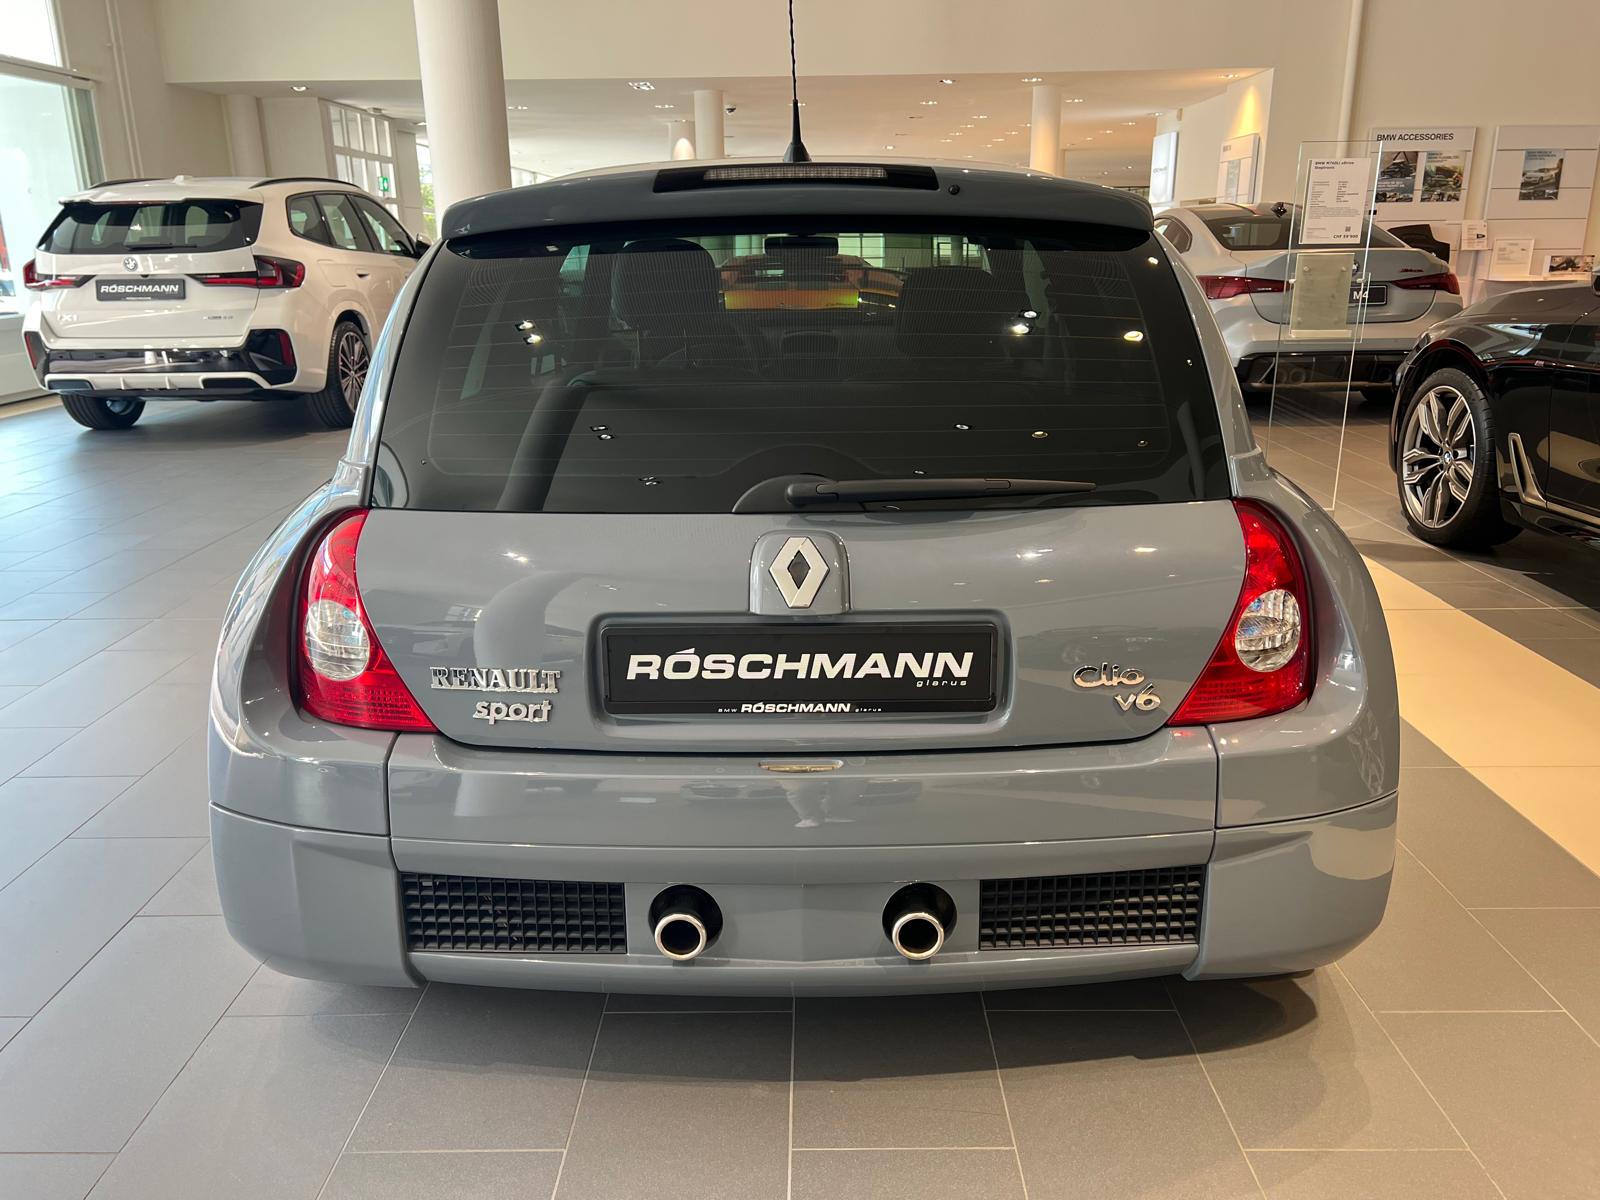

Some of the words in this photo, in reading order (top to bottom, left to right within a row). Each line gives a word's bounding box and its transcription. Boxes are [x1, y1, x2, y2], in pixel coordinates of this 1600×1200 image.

[1376, 134, 1397, 142] BMW
[1398, 133, 1454, 141] ACCESSORIES
[429, 666, 561, 694] RENAULT
[916, 678, 968, 688] glarus
[1072, 662, 1145, 688] Clio
[472, 699, 552, 725] sport
